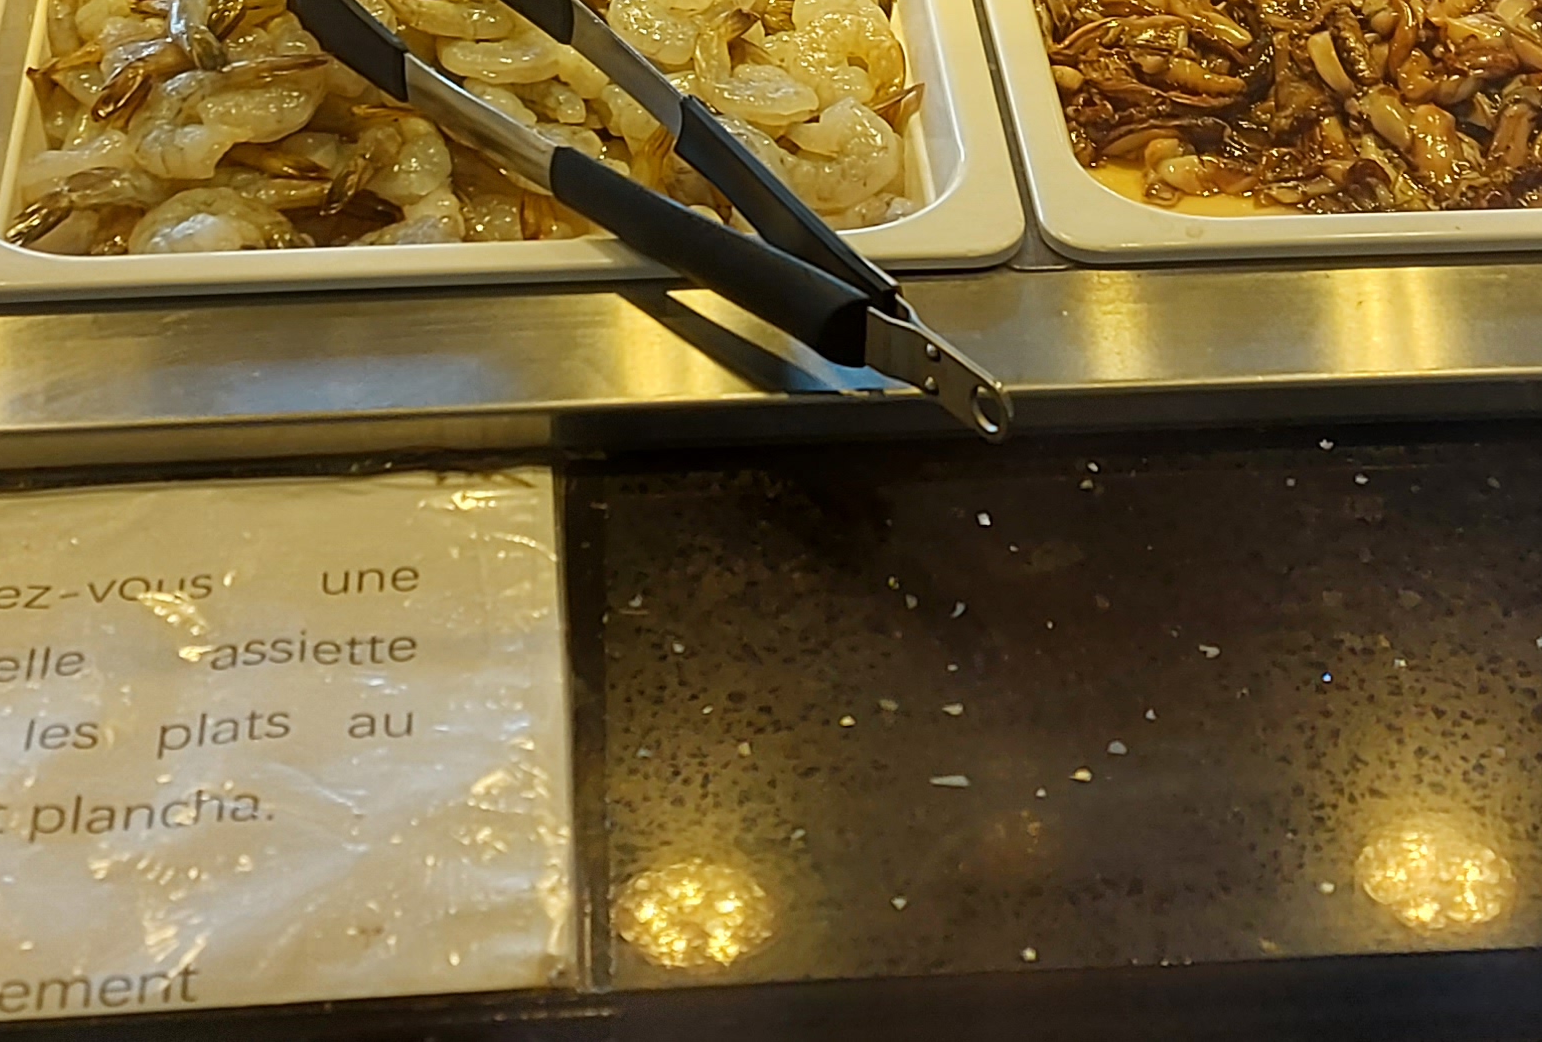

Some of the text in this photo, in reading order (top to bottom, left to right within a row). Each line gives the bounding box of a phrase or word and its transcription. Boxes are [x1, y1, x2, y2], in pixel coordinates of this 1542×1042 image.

[321, 564, 421, 596] une
[209, 628, 419, 672] assiette
[22, 718, 101, 752] les
[157, 709, 292, 760] plats
[347, 710, 415, 739] au
[27, 788, 276, 844] plancha.
